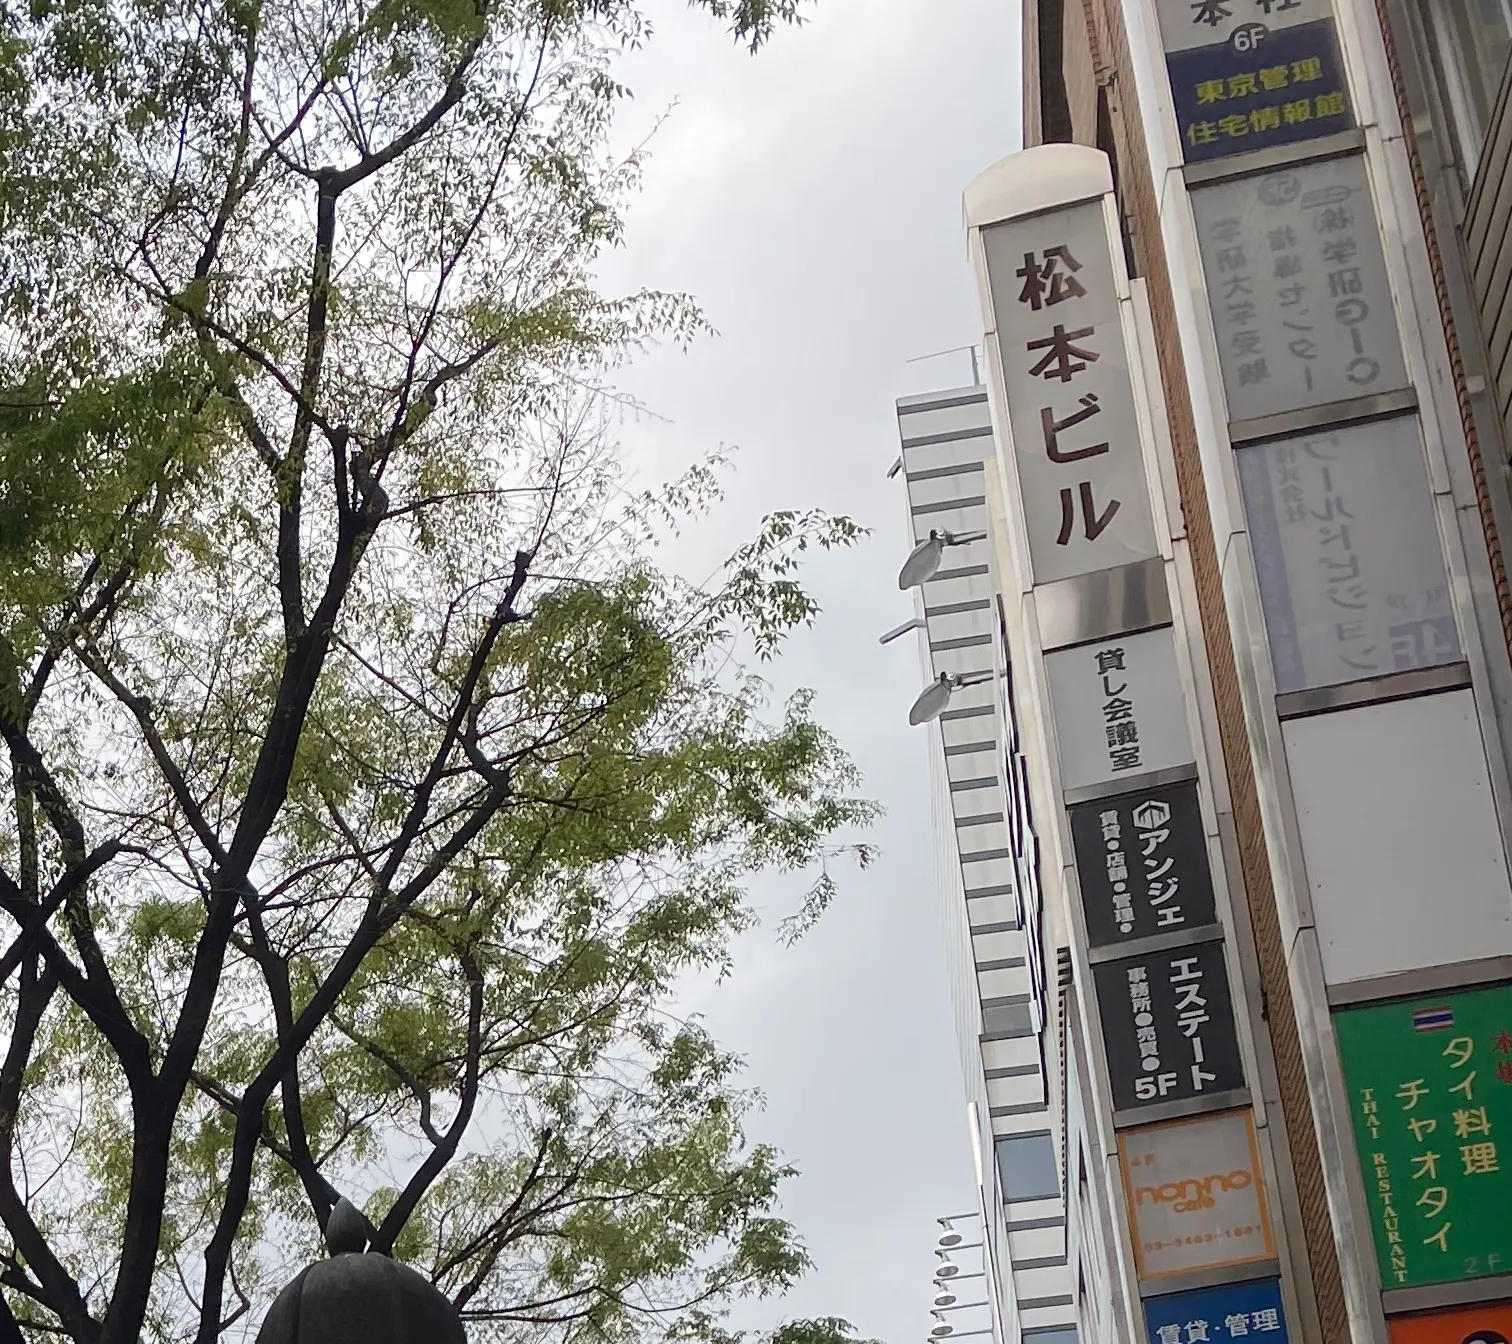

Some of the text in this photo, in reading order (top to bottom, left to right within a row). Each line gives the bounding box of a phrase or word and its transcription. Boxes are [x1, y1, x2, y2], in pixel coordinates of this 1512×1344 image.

[1194, 56, 1322, 104] 東京管理
[1234, 27, 1265, 51] 6F
[1187, 92, 1346, 146] 住宅情報館
[1016, 243, 1121, 547] 松本ビル
[1094, 647, 1143, 772] 貸し会議室
[1138, 828, 1185, 927] アンジェ
[1169, 955, 1216, 1091] エステート
[1134, 1072, 1178, 1100] 5F
[1442, 1036, 1500, 1176] タイ料理
[1360, 1088, 1408, 1283] THAI RESTAURANT
[1395, 1078, 1452, 1252] チャオタイ
[1465, 1253, 1502, 1275] 2F
